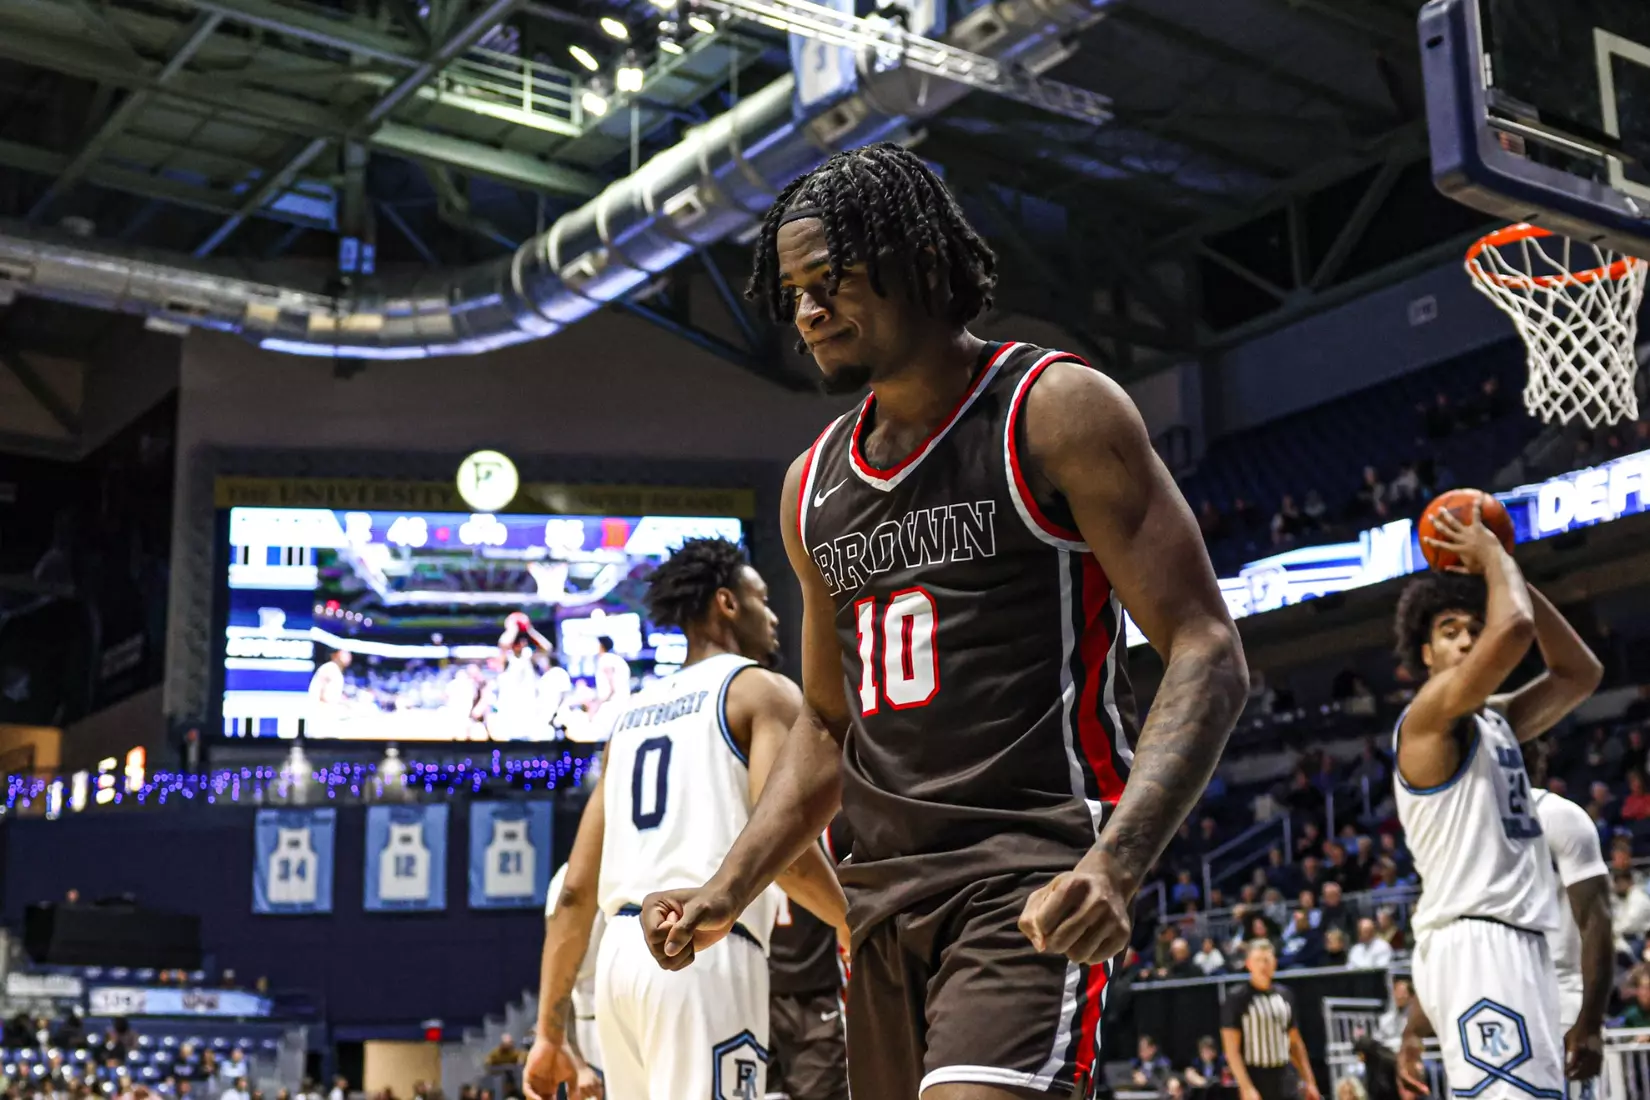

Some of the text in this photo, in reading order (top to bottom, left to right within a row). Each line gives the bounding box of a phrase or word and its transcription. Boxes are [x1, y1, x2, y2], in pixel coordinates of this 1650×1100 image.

[813, 500, 996, 596] BROWN
[854, 585, 940, 717] 10
[632, 735, 673, 831] 0
[277, 858, 307, 882] 34
[394, 855, 417, 878] 12
[498, 851, 523, 874] 21
